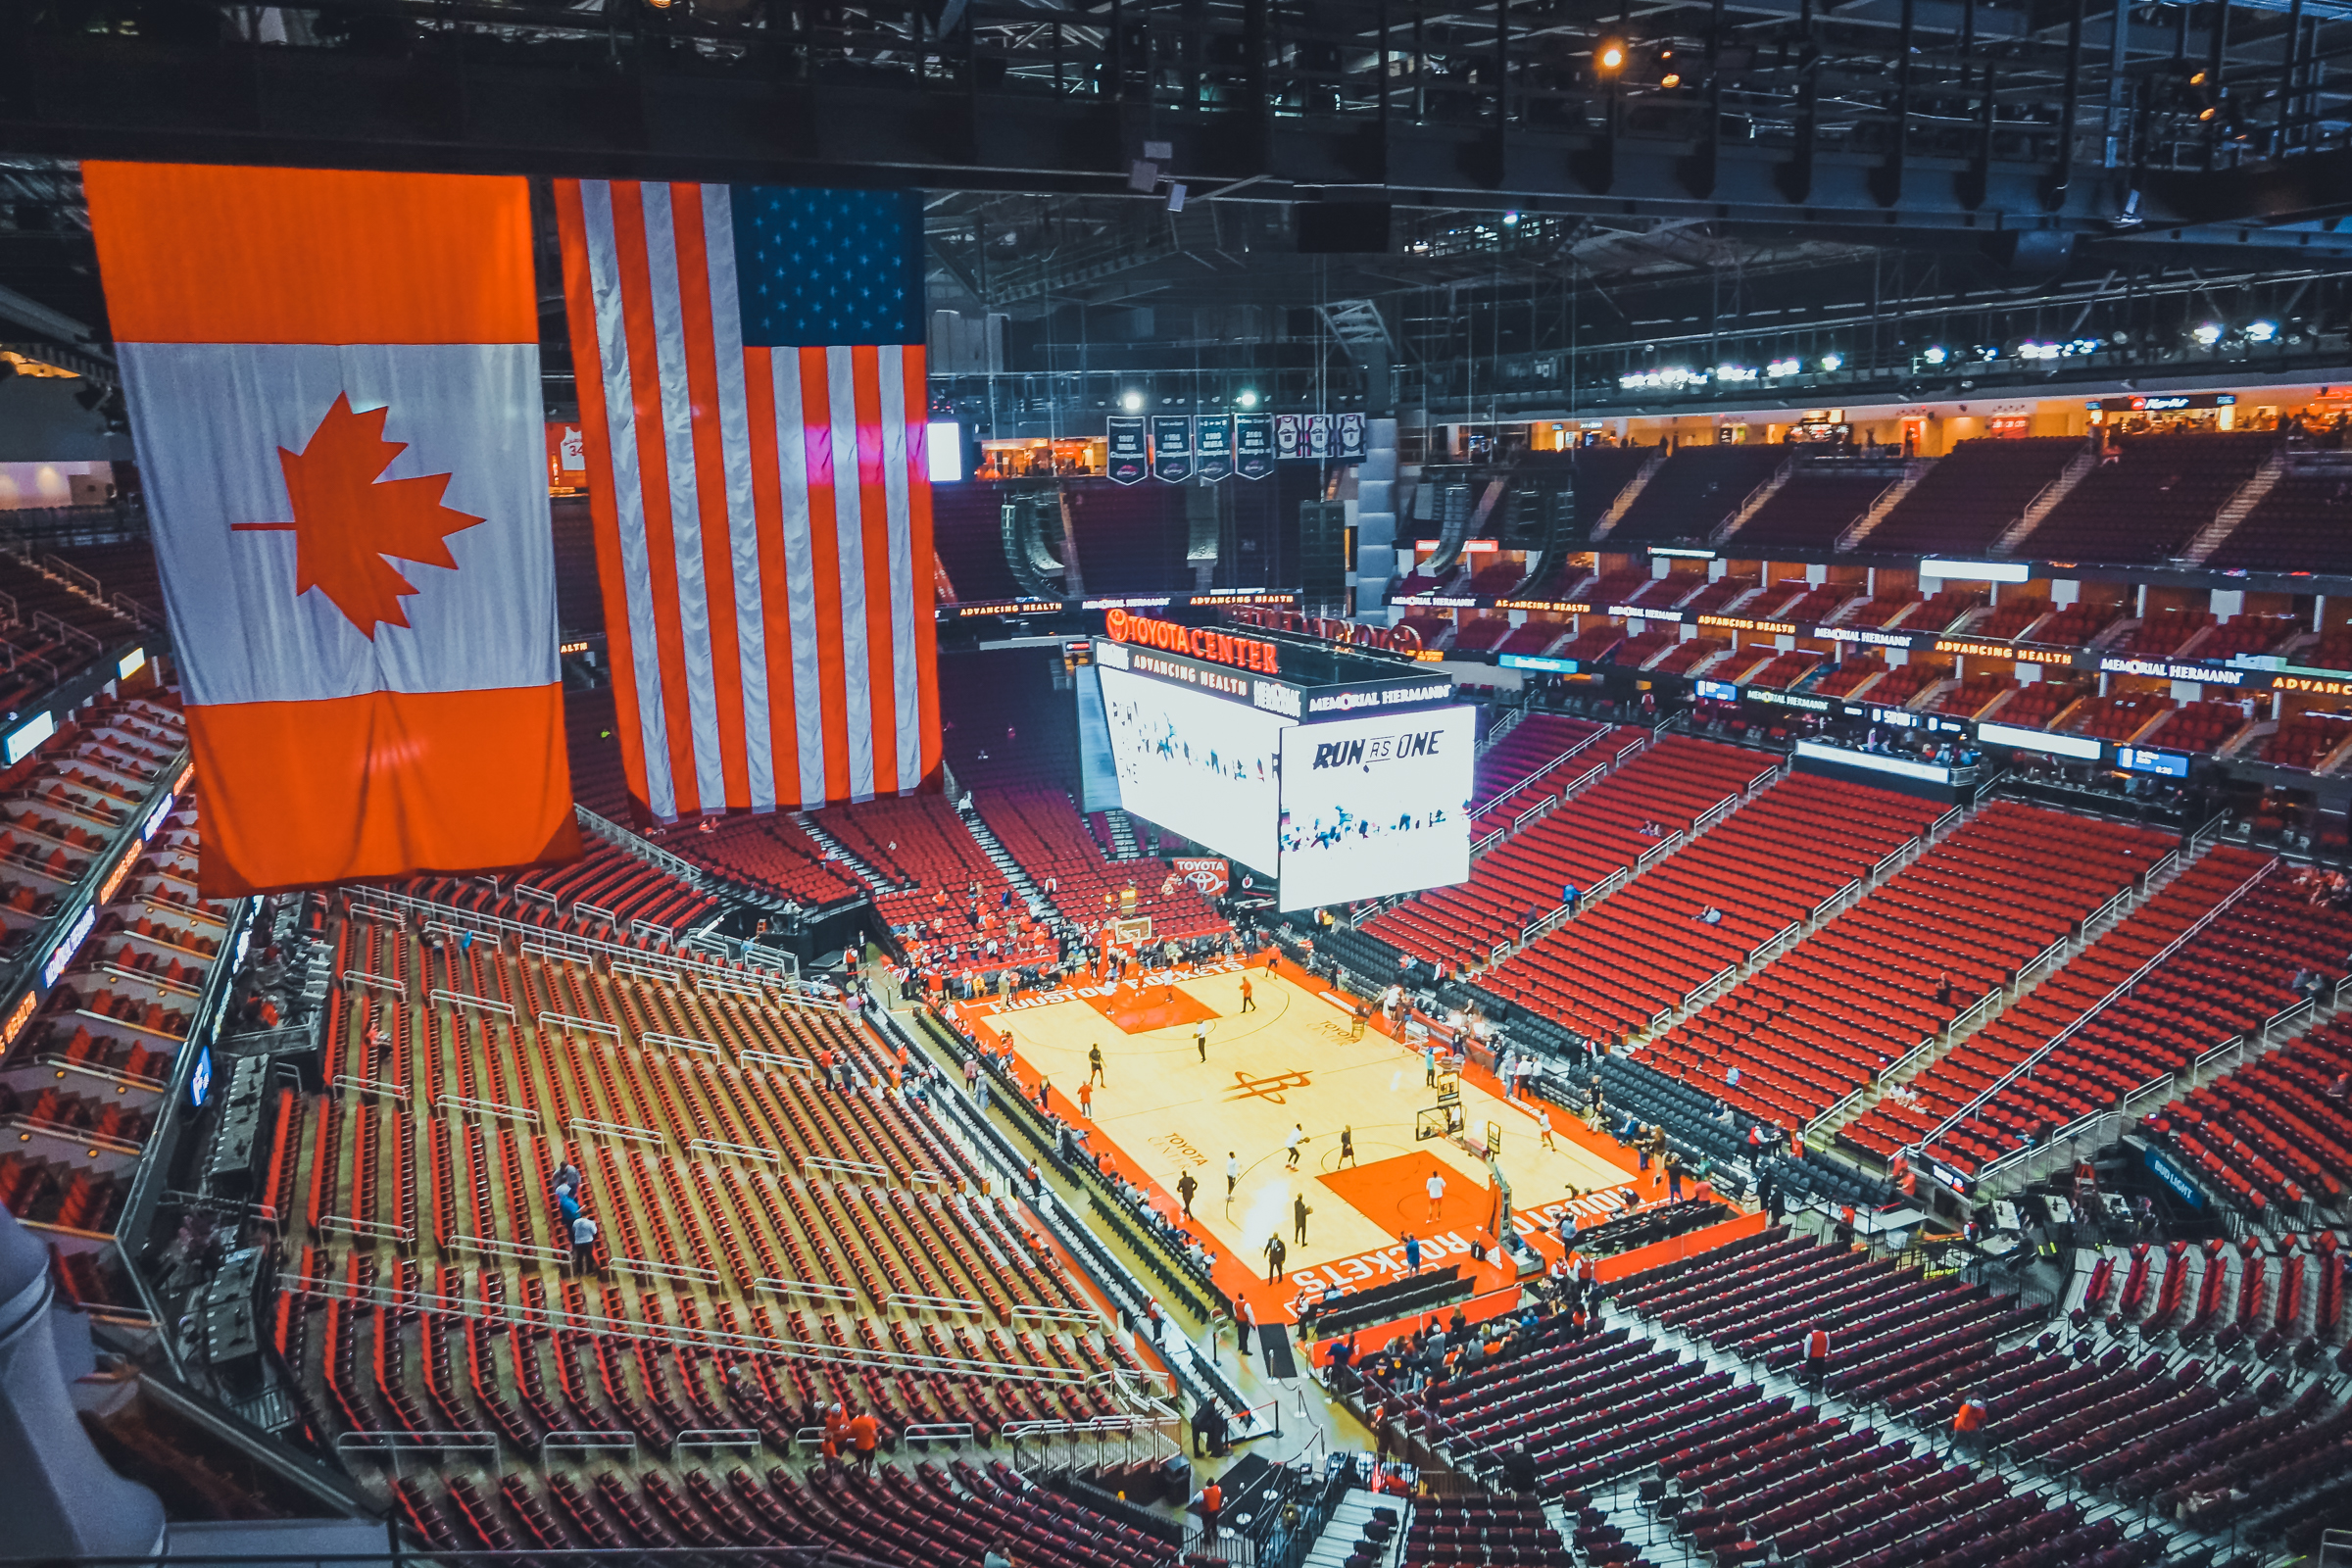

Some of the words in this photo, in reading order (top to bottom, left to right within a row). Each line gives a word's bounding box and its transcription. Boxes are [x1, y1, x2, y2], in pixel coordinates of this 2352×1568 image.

[960, 605, 1019, 616] ADVANCING
[1023, 602, 1062, 612] HEALTH
[1698, 615, 1754, 629] ADVANCING
[1756, 621, 1796, 634] HEALTH
[1128, 615, 1191, 654] TOYOTA
[1191, 628, 1280, 674] CENTER
[1861, 632, 1912, 647] HERMANN
[1936, 641, 2013, 658] ADVANCING
[2017, 650, 2072, 664] HEALTH
[1134, 655, 1196, 683] ADVANCING
[1200, 670, 1248, 697] HEALTH
[2100, 658, 2167, 678] MEMORIAL
[2169, 665, 2243, 684] HERMANN
[1309, 691, 1380, 711] MEMORIAL
[1382, 685, 1451, 705] HERMANN
[1312, 739, 1366, 770] RUN
[1370, 740, 1391, 759] AS
[1396, 730, 1445, 759] ONE
[1177, 860, 1225, 871] TOYOTA
[1164, 1132, 1208, 1166] TOYOTA
[2169, 1173, 2193, 1199] LIGHT
